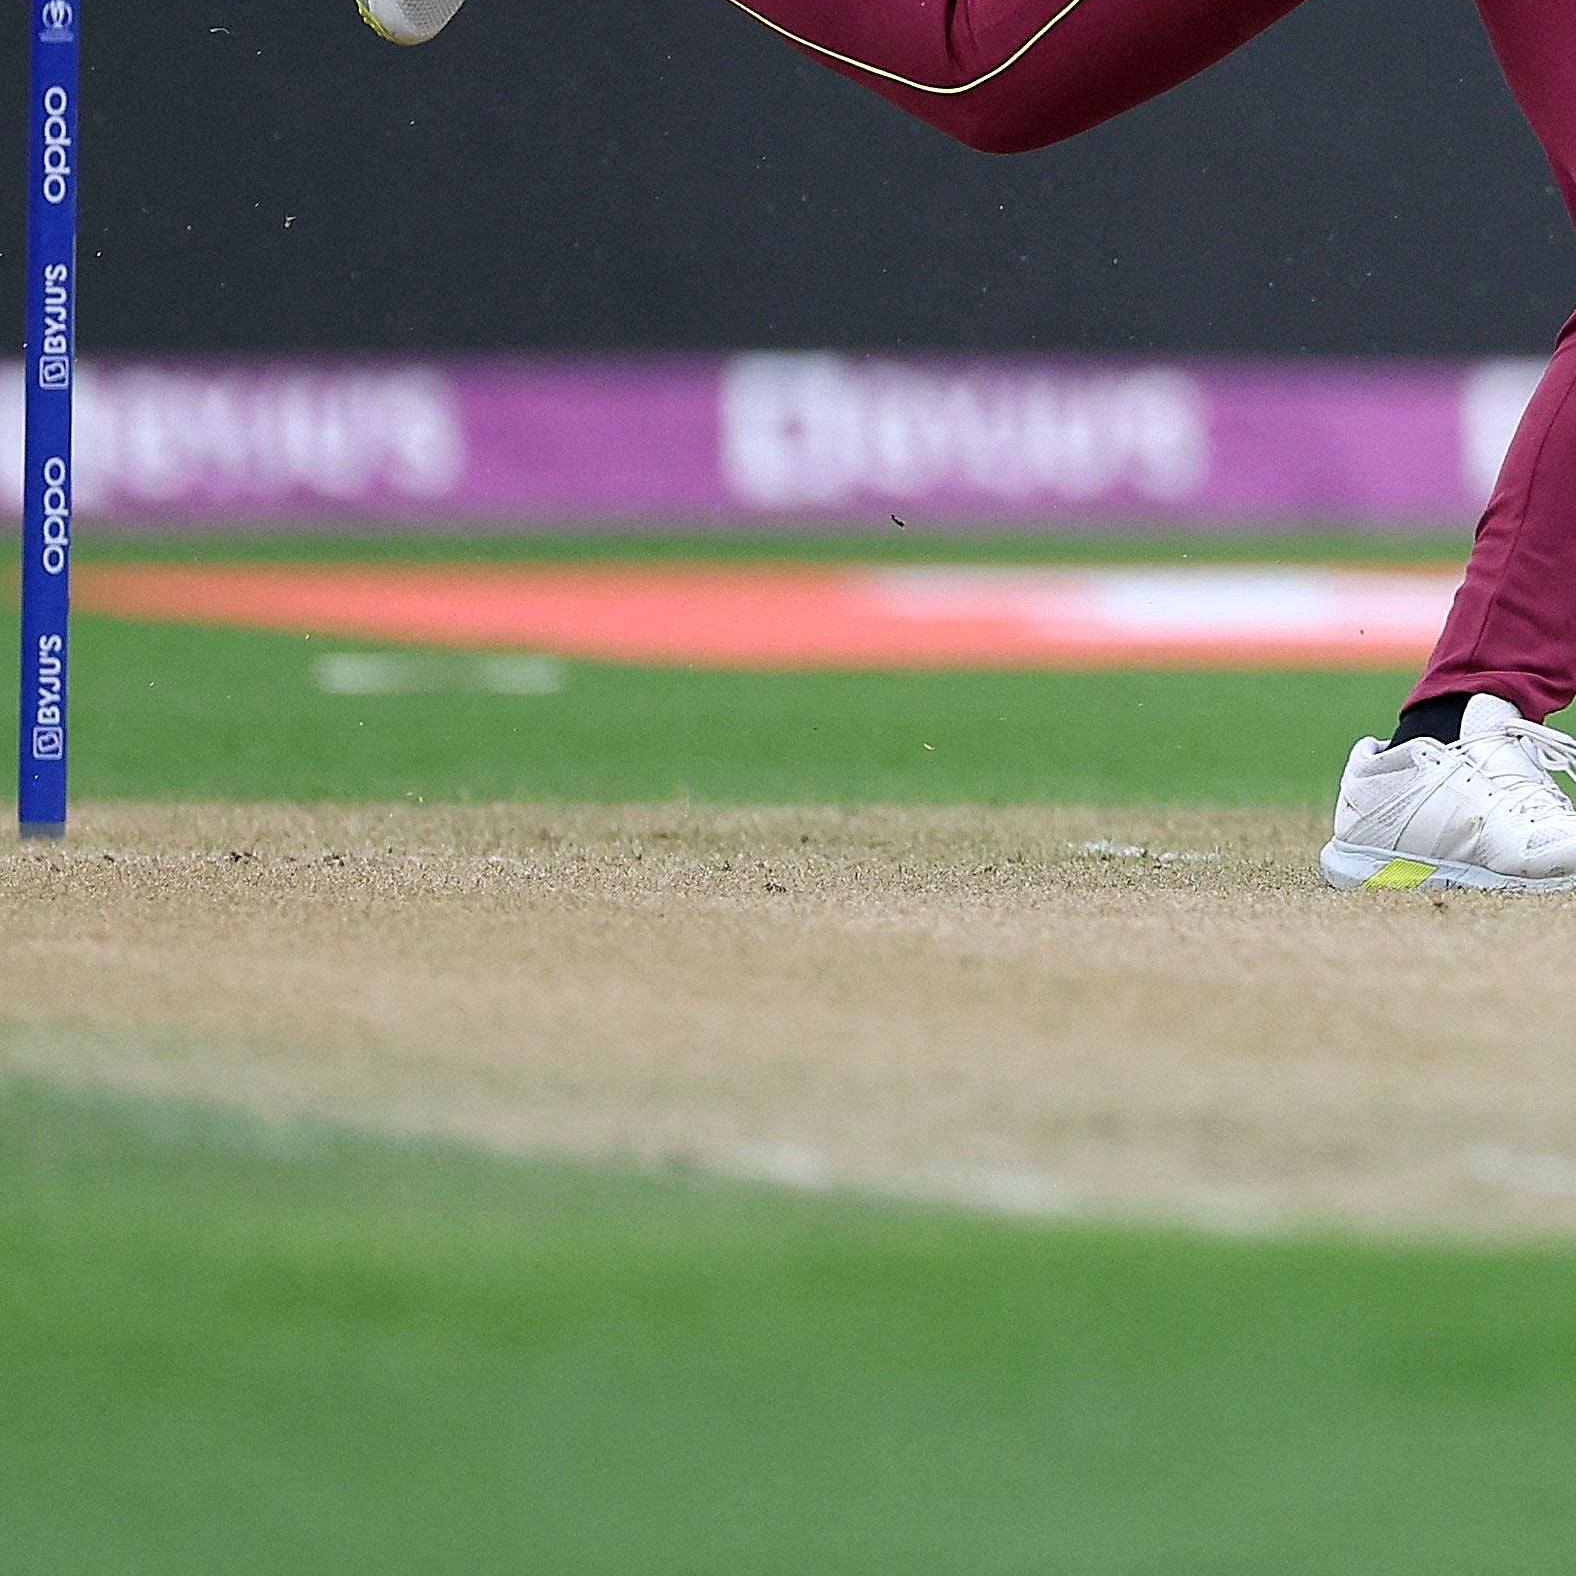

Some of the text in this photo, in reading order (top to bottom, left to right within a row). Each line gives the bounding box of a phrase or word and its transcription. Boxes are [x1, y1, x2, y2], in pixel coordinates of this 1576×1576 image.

[43, 86, 71, 204] oppo
[43, 263, 68, 355] BYJU'S
[43, 456, 69, 575] oppo
[37, 634, 62, 725] BYJU'S
